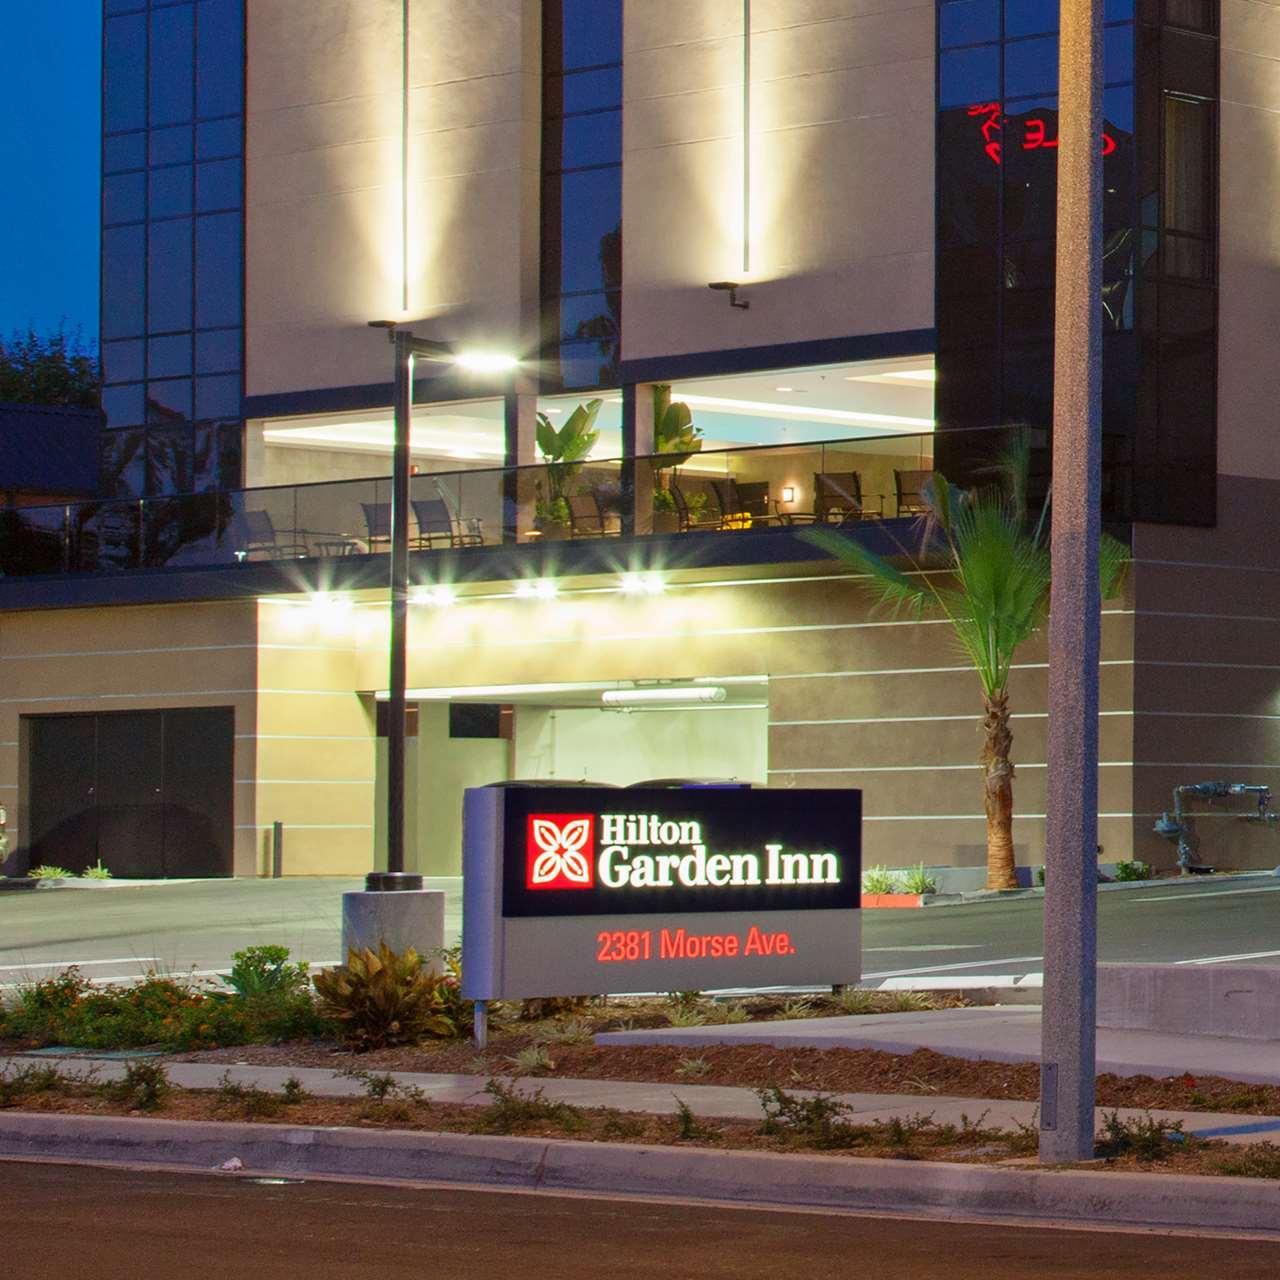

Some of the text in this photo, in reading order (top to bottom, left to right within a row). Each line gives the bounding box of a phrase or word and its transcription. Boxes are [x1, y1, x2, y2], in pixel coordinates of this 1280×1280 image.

[600, 814, 702, 845] Hilton
[598, 844, 840, 888] Garden Inn
[597, 925, 796, 961] 2381 Morse Ave.
